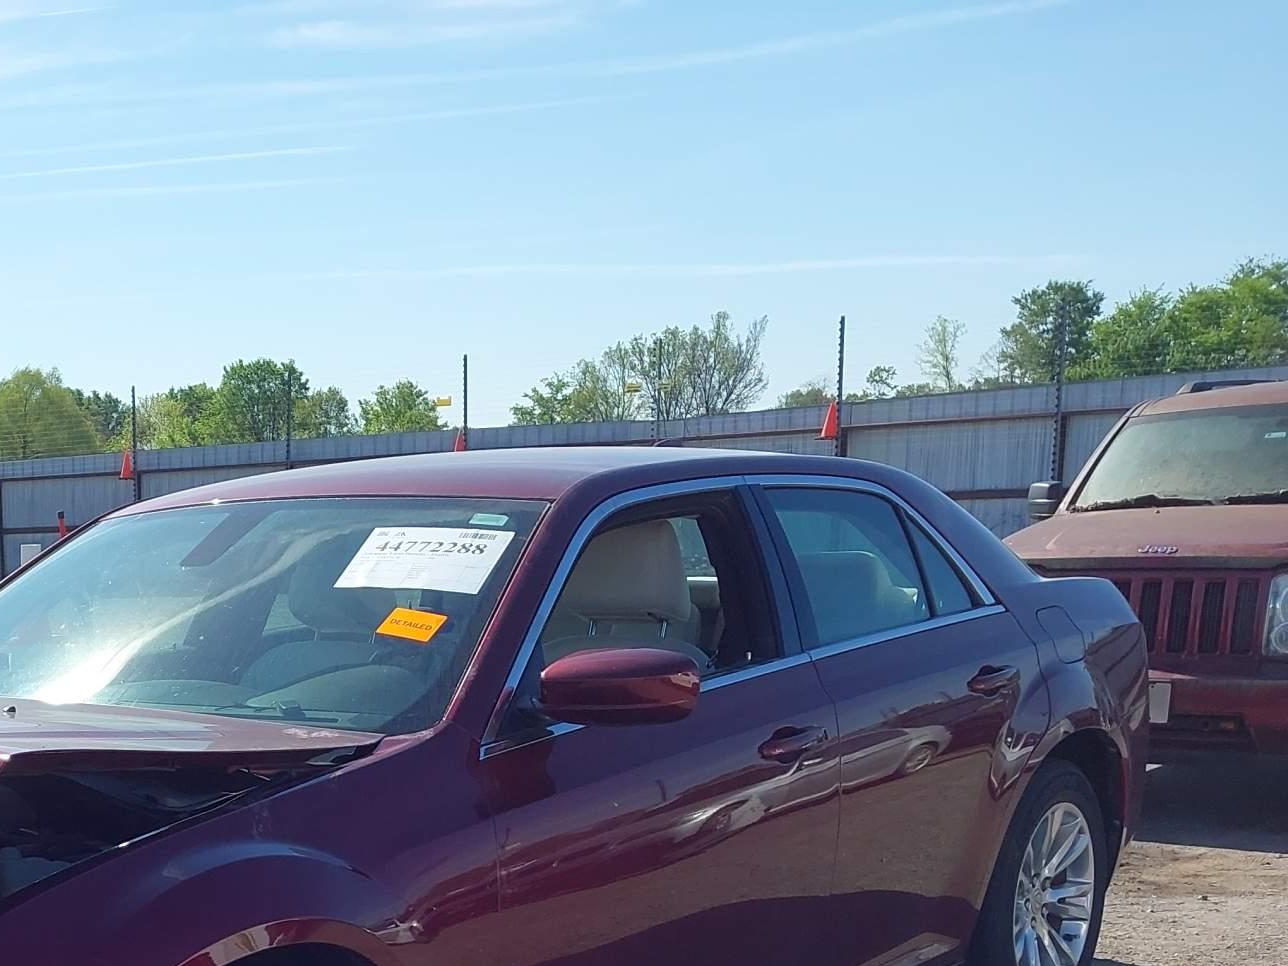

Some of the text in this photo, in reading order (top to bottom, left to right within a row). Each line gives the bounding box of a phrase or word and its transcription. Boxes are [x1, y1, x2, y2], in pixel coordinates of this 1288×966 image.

[375, 540, 488, 555] 44772288
[1137, 544, 1179, 555] Jeep
[390, 618, 433, 631] DETAILED
